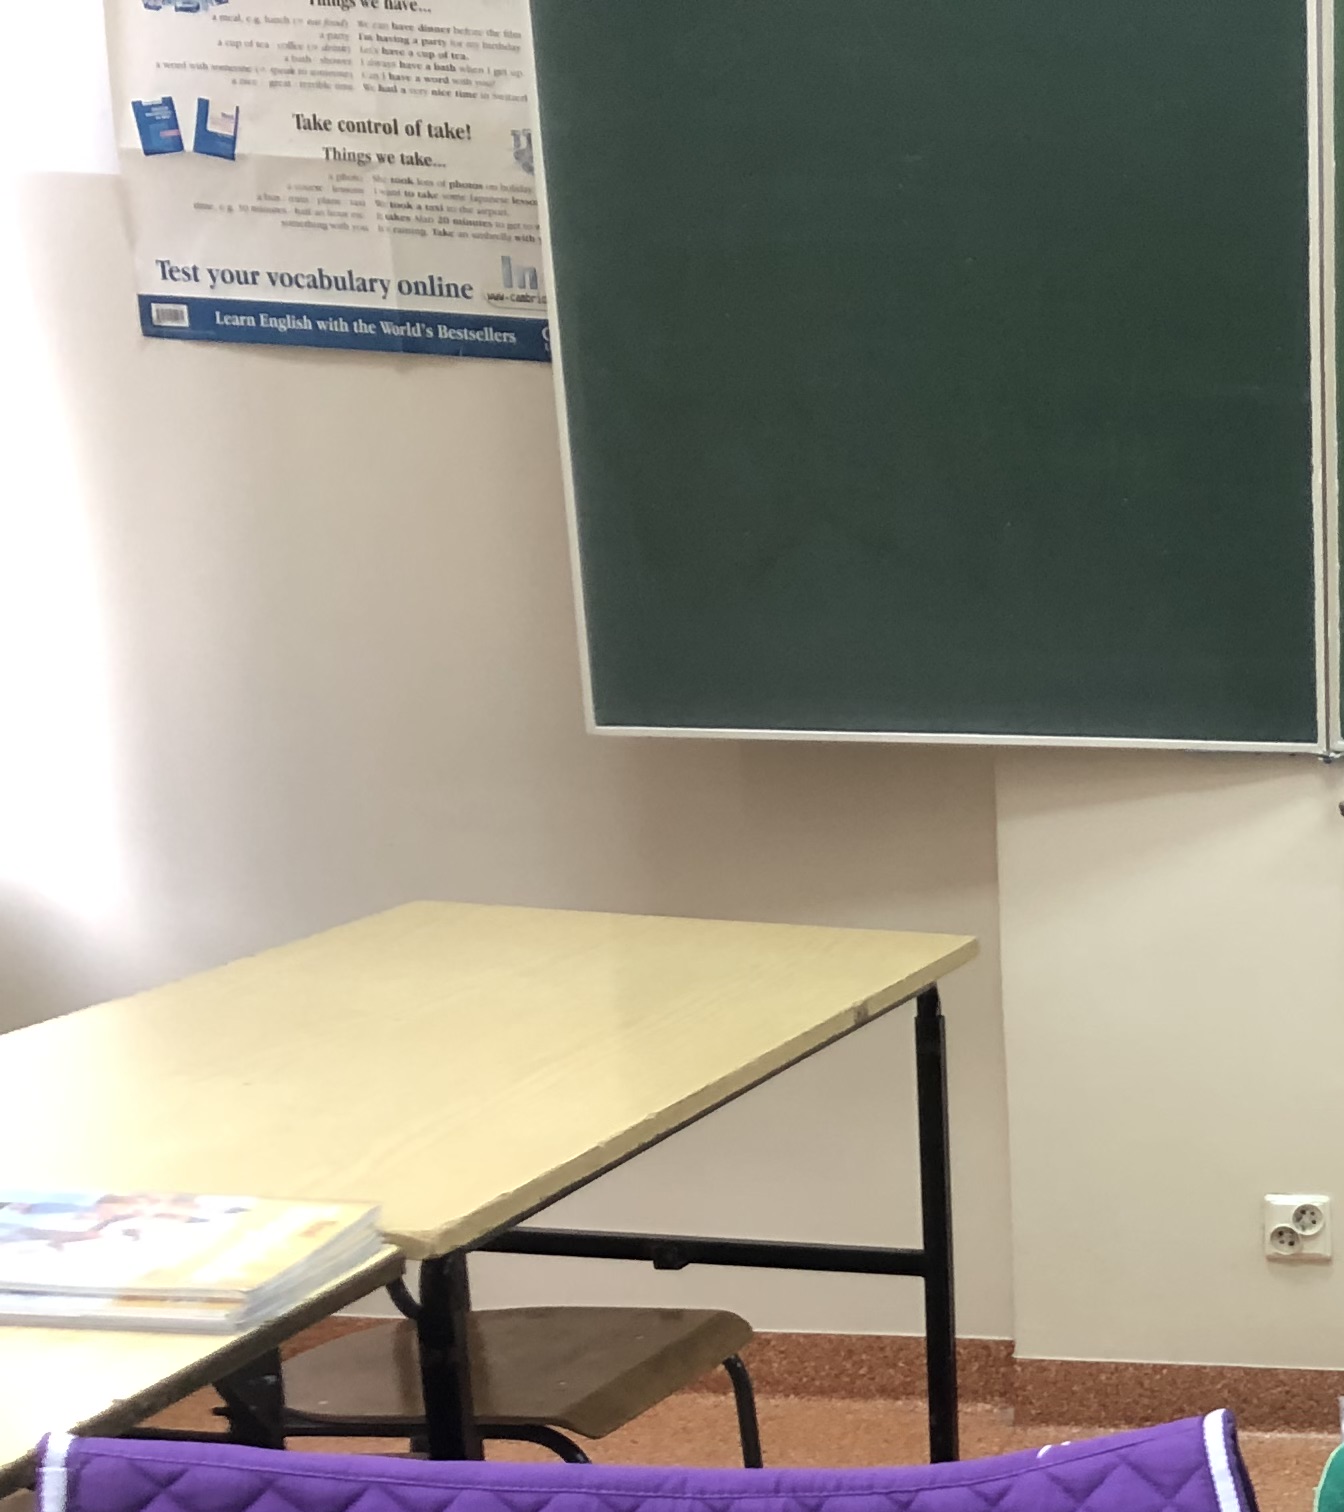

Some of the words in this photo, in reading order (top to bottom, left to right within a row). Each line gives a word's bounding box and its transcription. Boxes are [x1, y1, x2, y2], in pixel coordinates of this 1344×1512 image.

[293, 112, 332, 132] Take
[338, 118, 399, 137] control
[405, 120, 424, 137] of
[427, 122, 471, 140] take!
[323, 147, 371, 166] Things
[376, 152, 395, 163] we
[156, 259, 200, 283] Test
[206, 267, 259, 292] your
[268, 268, 390, 296] vocabulary
[398, 280, 474, 300] online
[215, 310, 255, 328] Learn
[258, 312, 313, 333] English
[316, 315, 349, 332] with
[353, 318, 376, 334] the
[380, 319, 434, 338] World's
[438, 323, 516, 344] Bestsellers
